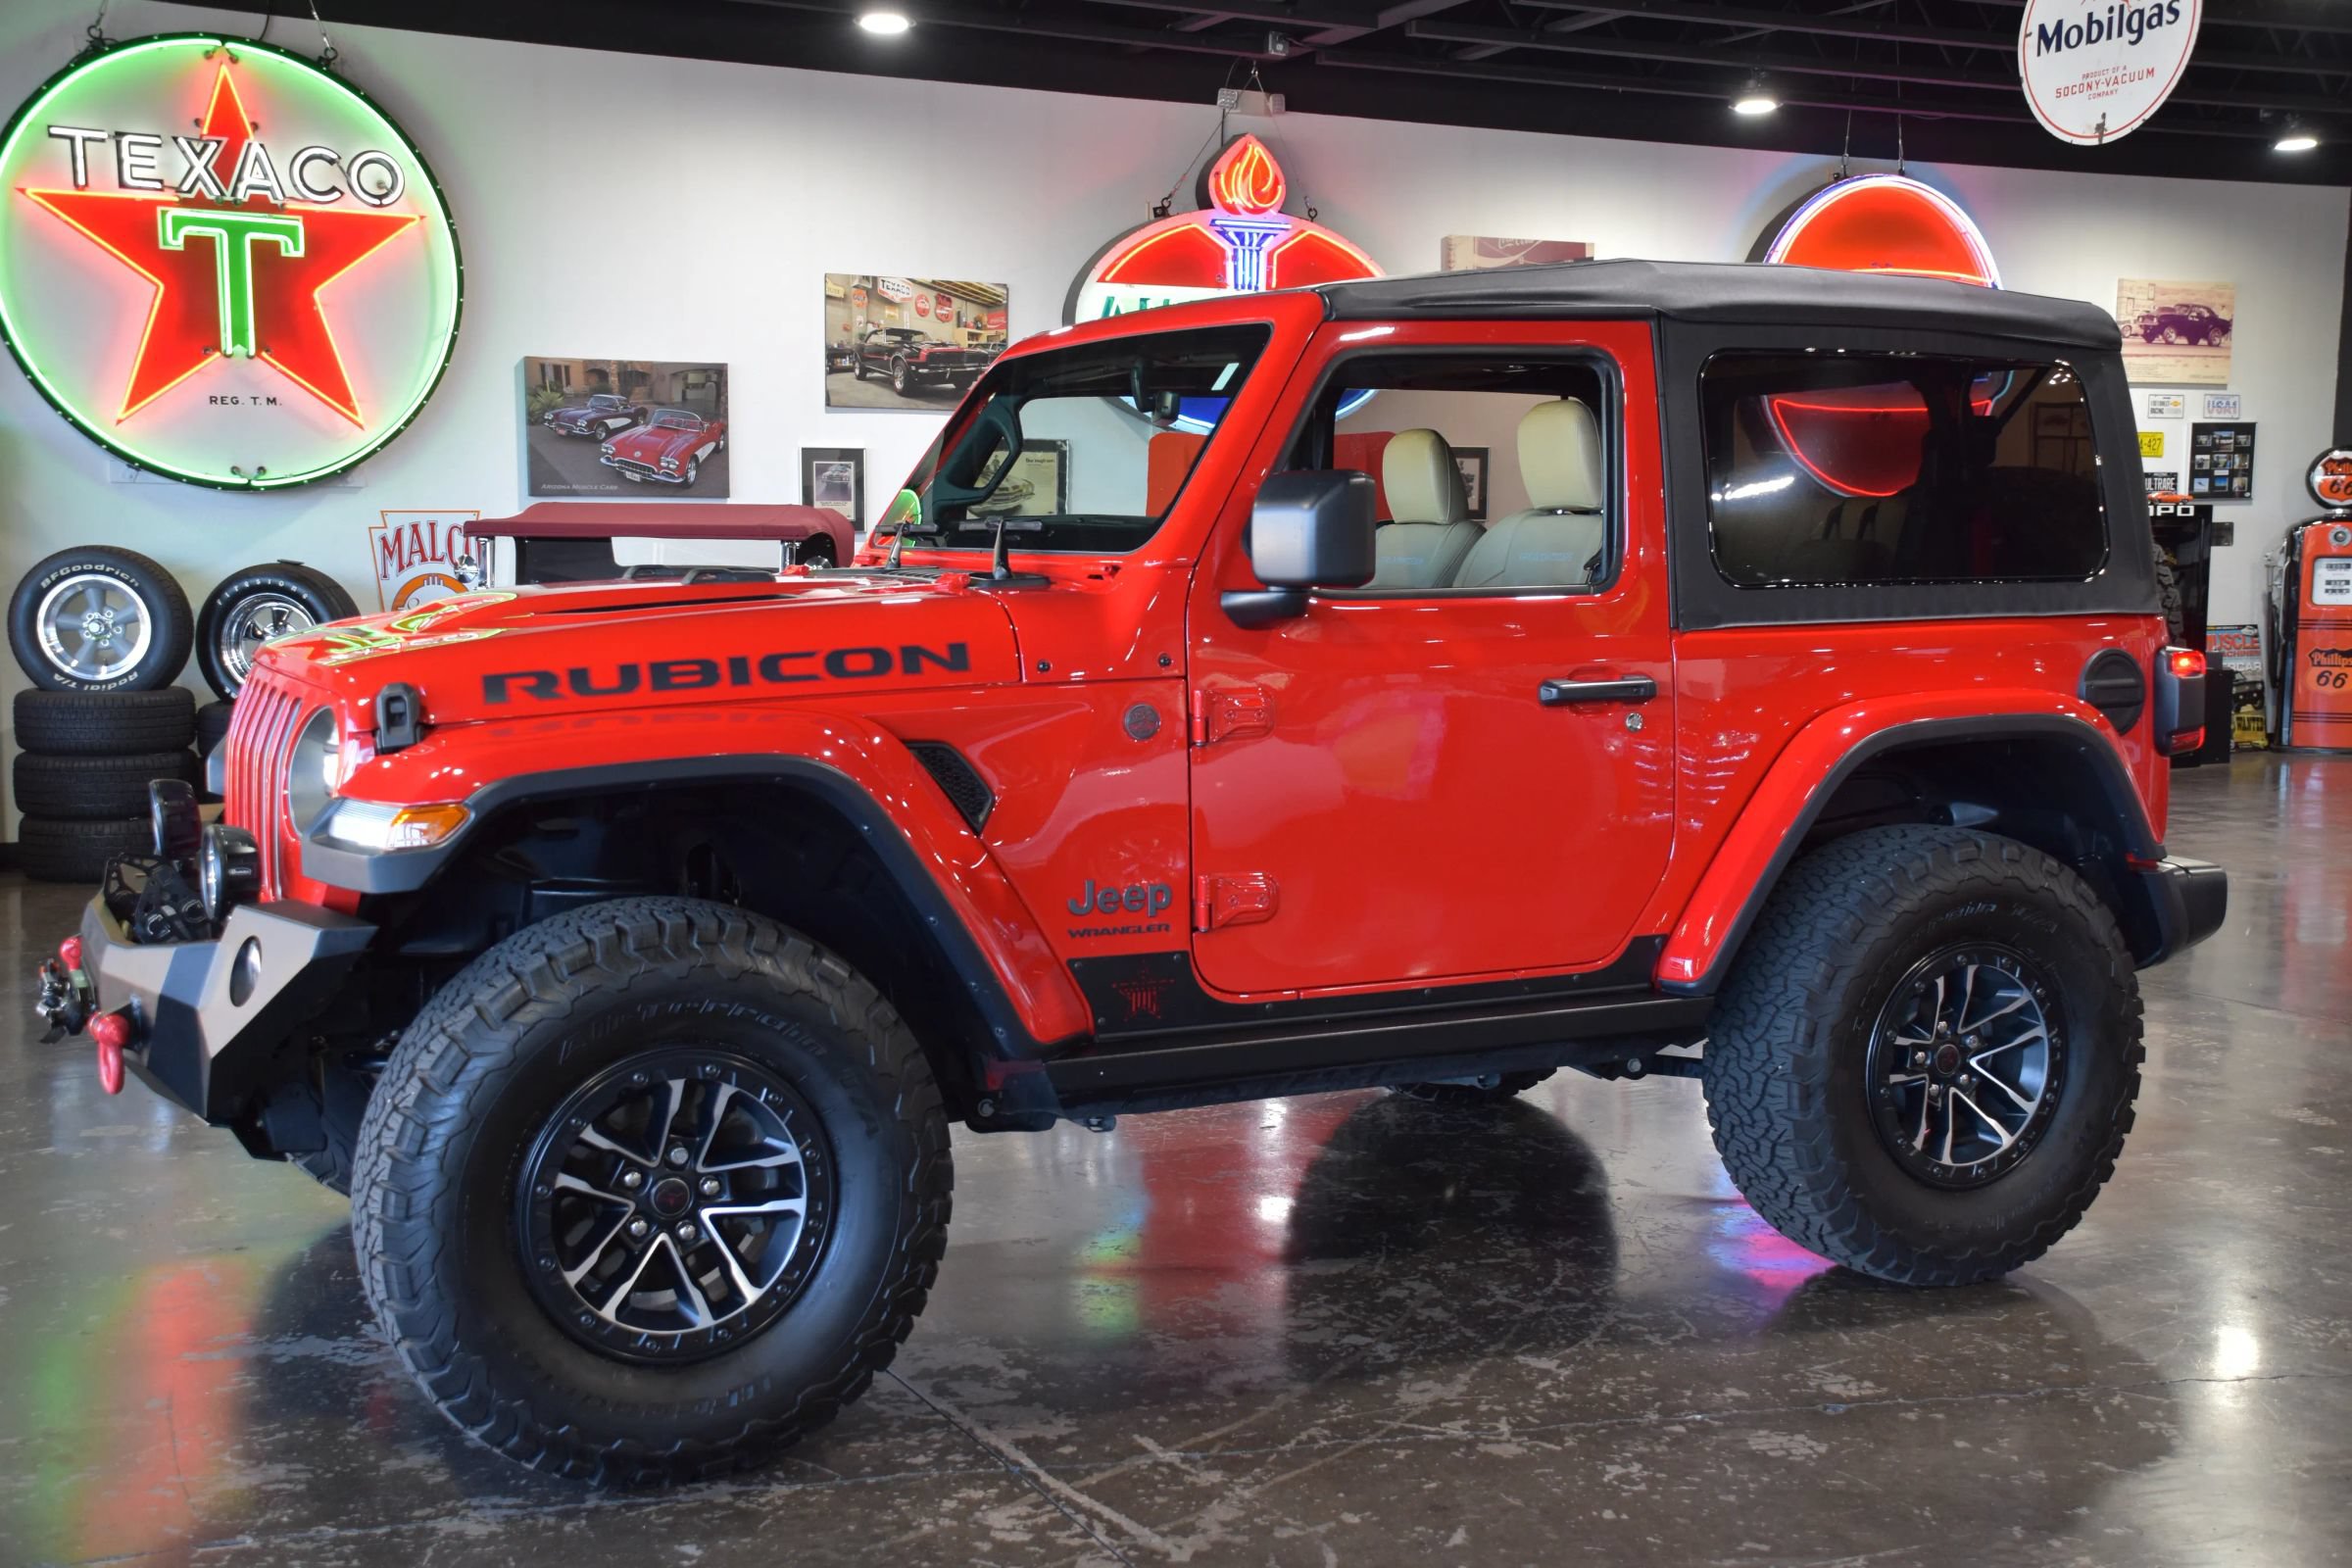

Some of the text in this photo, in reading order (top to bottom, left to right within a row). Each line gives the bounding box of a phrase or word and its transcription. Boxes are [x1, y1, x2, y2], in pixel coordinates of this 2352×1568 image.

[2036, 0, 2180, 57] Mobilgas
[2055, 68, 2156, 99] SOCONY-VACUUM
[2082, 69, 2110, 79] PRODUCT
[2088, 88, 2119, 100] COMPANY
[48, 124, 406, 206] TEXACO
[209, 395, 245, 407] REG.
[40, 564, 139, 588] BFGoodrich
[54, 671, 138, 691] Radial T/A
[481, 642, 970, 705] RUBICON
[2317, 670, 2348, 689] 66
[1067, 879, 1173, 917] Jeep
[1067, 922, 1171, 939] WRANGLER
